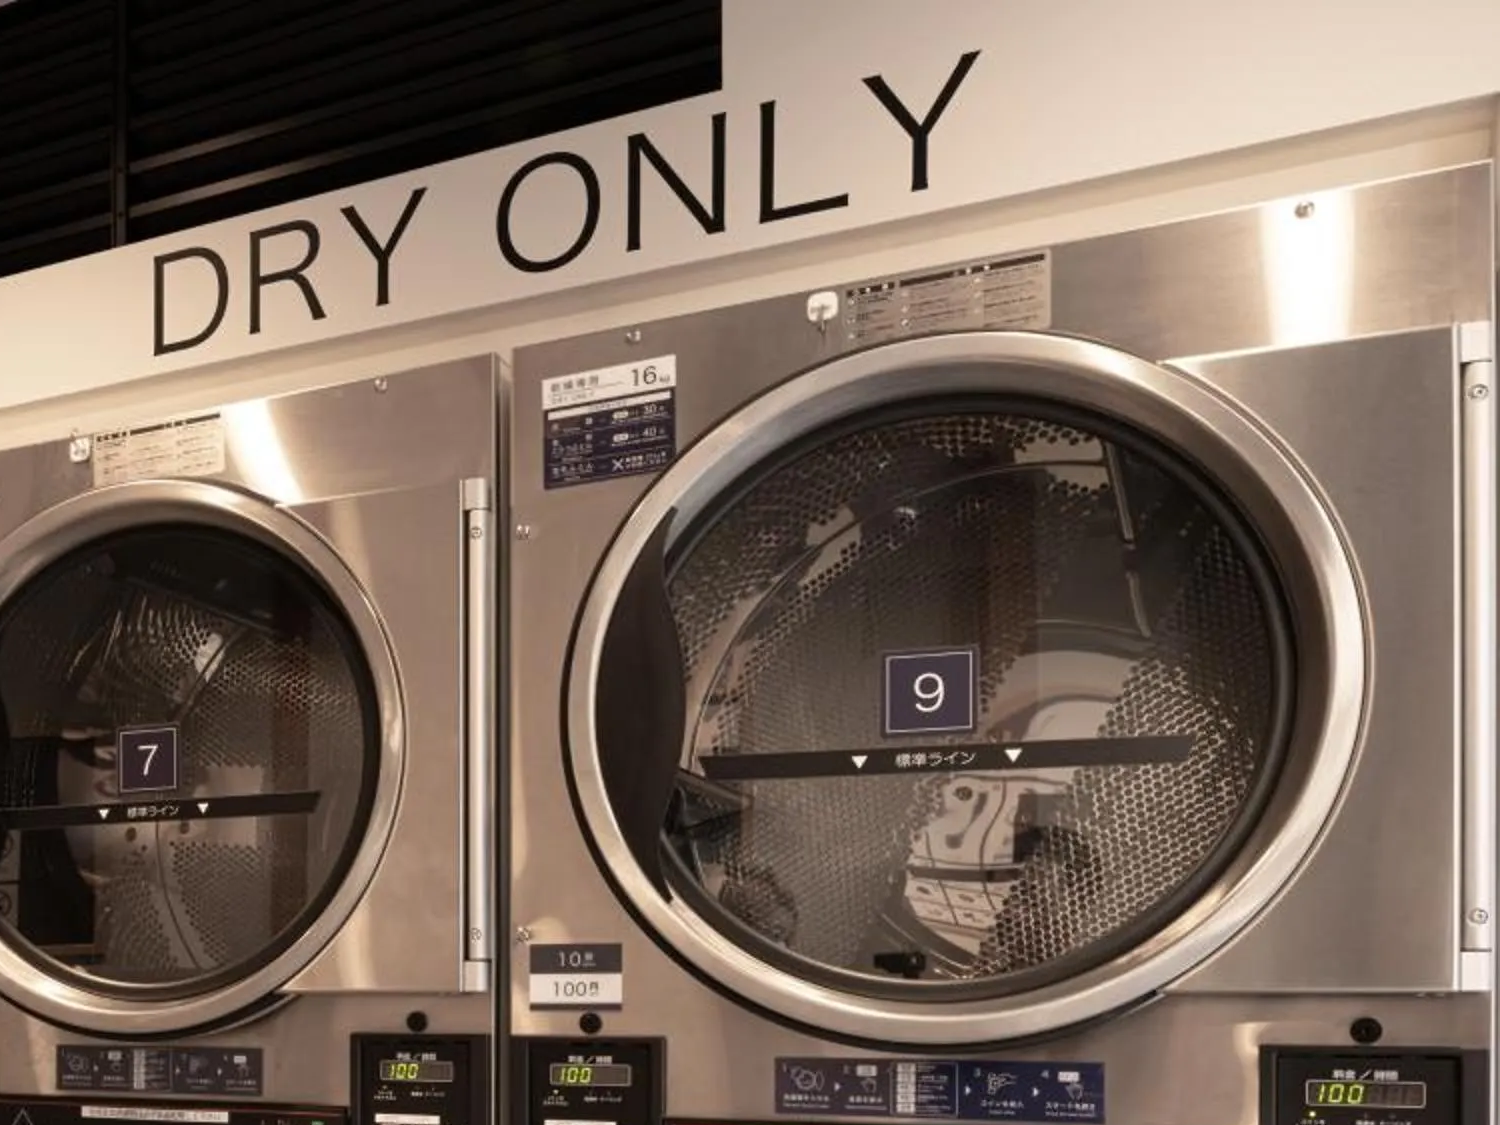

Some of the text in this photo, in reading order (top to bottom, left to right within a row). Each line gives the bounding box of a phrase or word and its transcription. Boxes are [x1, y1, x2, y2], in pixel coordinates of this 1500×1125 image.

[153, 50, 981, 357] DRY ONLY
[913, 672, 945, 713] 9
[137, 744, 159, 777] 7
[895, 750, 977, 769] 標準ライン
[389, 1062, 419, 1080] 100
[560, 1067, 592, 1083] 100
[1316, 1083, 1365, 1105] 100
